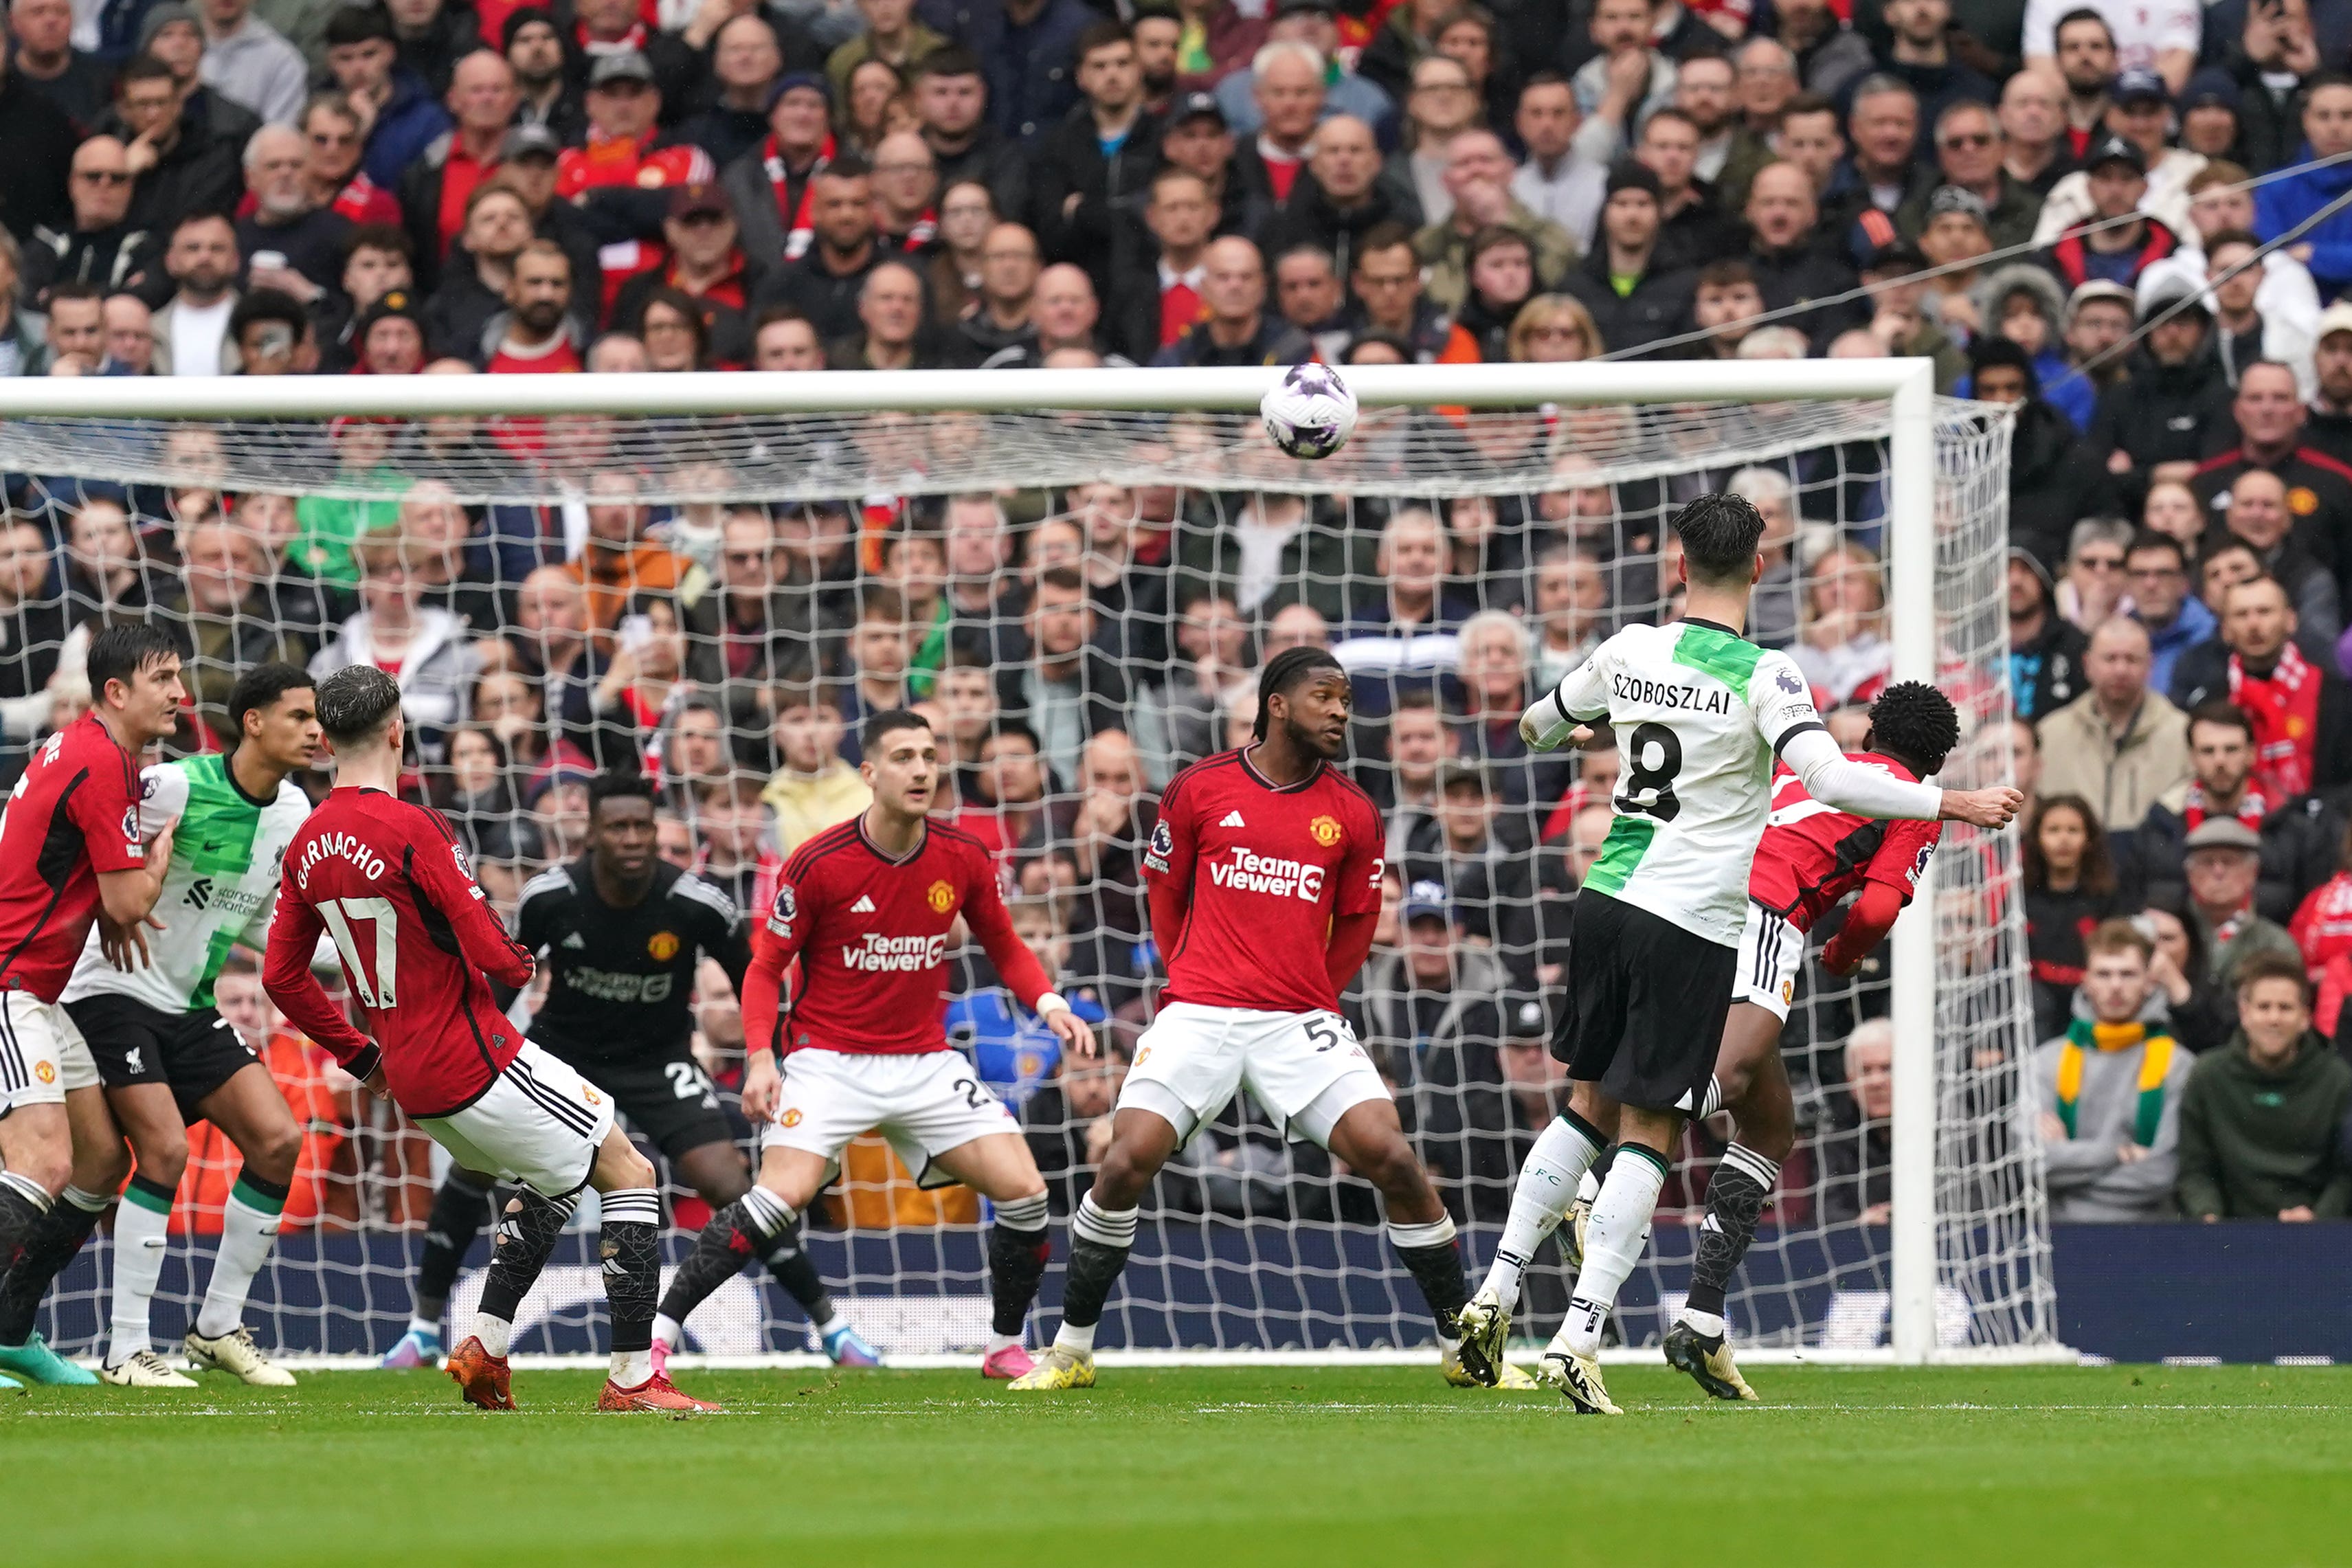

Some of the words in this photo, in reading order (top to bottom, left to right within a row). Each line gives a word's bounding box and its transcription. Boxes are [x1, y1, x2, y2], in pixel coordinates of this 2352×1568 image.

[1613, 673, 1731, 715] SZOBOSZLAI
[1615, 721, 1683, 823] 8
[298, 831, 385, 890] GARNACHO
[1231, 846, 1301, 880] Team
[218, 887, 262, 905] standar
[1210, 862, 1298, 897] Viewer
[315, 897, 398, 1010] 17
[842, 945, 926, 972] Viewer
[862, 932, 928, 955] Team
